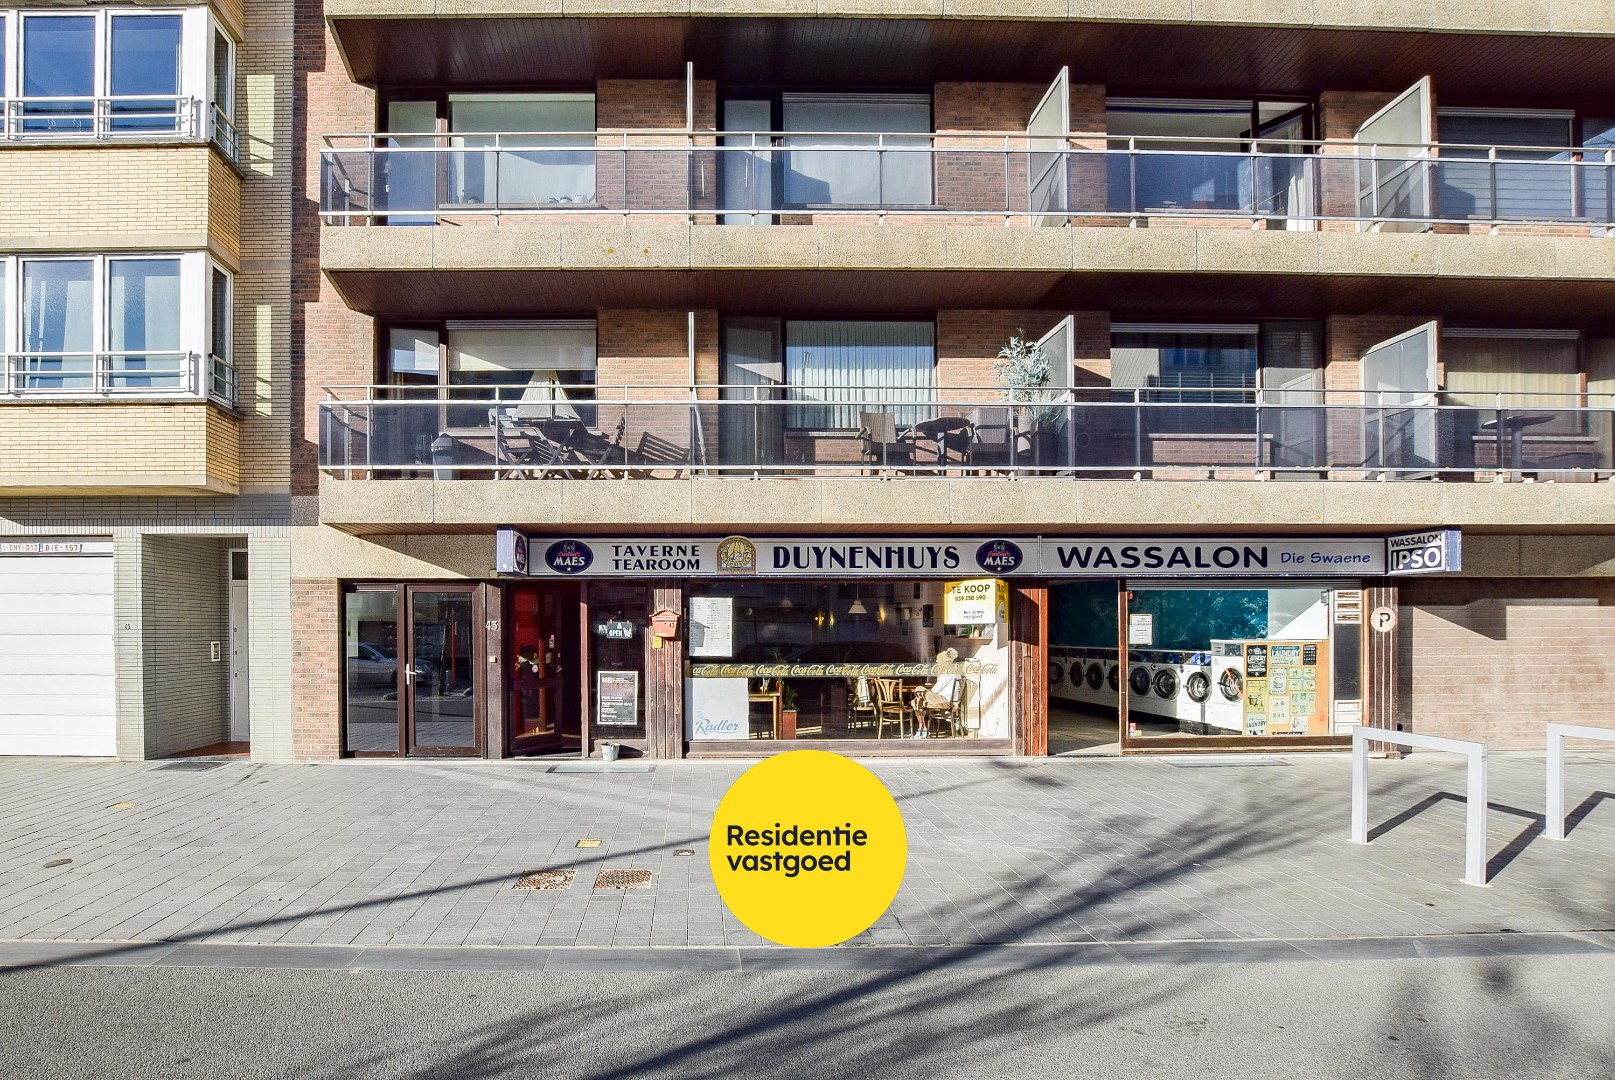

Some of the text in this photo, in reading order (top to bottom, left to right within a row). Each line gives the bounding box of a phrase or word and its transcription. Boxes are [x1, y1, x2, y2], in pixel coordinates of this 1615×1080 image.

[1391, 533, 1442, 547] WASSALON
[612, 545, 700, 557] TAVERNE
[553, 556, 585, 566] MAES
[773, 546, 960, 569] DUYNENHUYS
[984, 556, 1015, 566] MAES
[1056, 546, 1268, 569] WASSALON
[1281, 552, 1371, 564] Die Swaene
[1392, 547, 1441, 570] IPSO
[612, 558, 700, 570] TEAROOM
[952, 586, 962, 594] TE
[964, 584, 991, 593] KOOP
[485, 620, 499, 630] 43
[609, 629, 623, 637] OPEN
[696, 718, 739, 735] Radler
